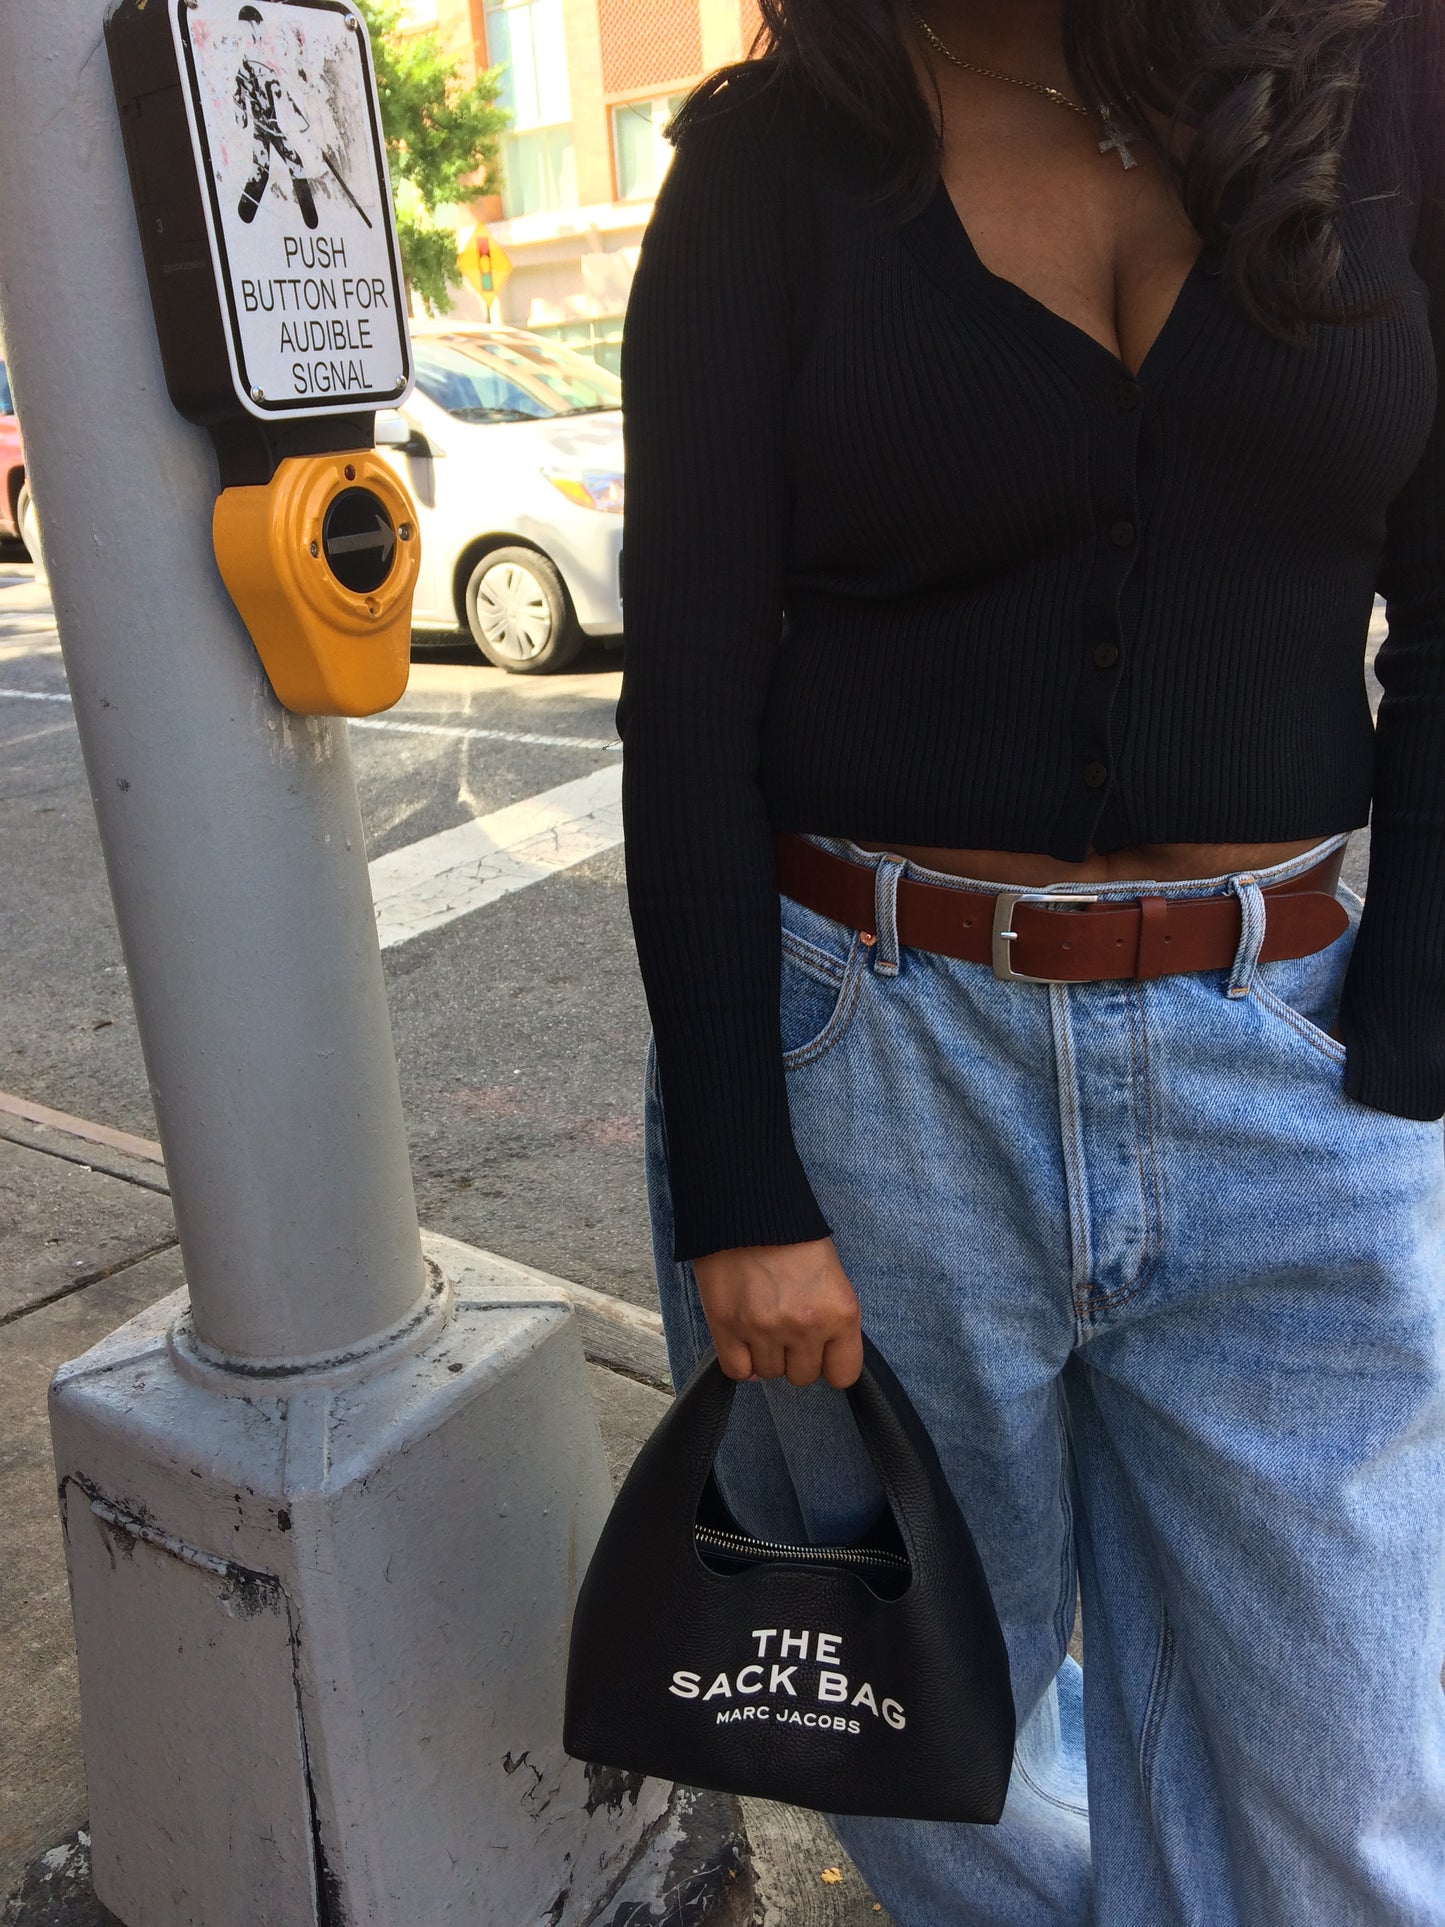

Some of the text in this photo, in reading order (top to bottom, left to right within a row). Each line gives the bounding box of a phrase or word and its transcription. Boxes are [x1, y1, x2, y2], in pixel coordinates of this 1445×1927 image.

[283, 236, 347, 268] PUSH
[240, 278, 389, 312] BUTTON FOR
[280, 319, 373, 353] AUDIBLE
[292, 359, 373, 394] SIGNAL
[752, 1629, 842, 1665] THE
[668, 1665, 906, 1730] SACK BAG
[716, 1706, 861, 1734] MARC JACOBS
